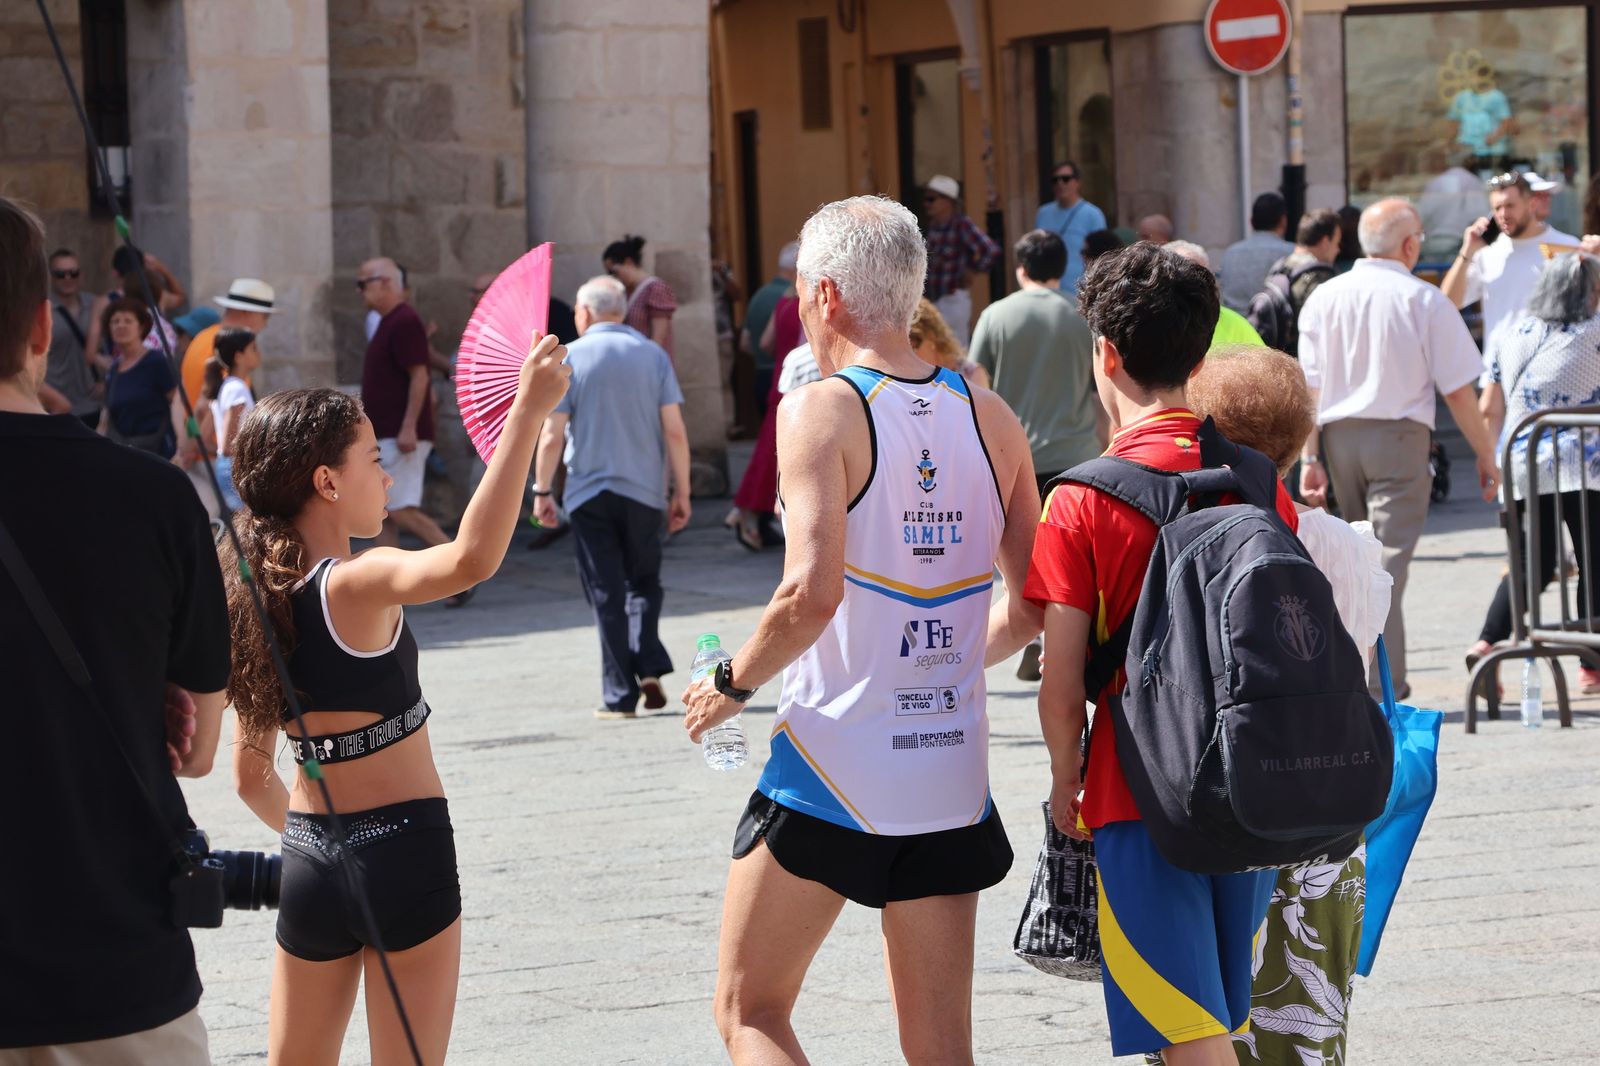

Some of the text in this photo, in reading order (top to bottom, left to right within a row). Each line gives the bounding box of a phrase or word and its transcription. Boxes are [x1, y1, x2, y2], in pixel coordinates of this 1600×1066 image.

[904, 525, 962, 544] SAMIL
[915, 652, 962, 670] seguros
[898, 693, 933, 701] CONCELLO
[913, 701, 930, 709] VIGO
[338, 731, 365, 757] THE
[367, 714, 402, 749] TRUE
[920, 738, 965, 748] PONTEVEDRA
[1260, 755, 1346, 772] VILLARREAL
